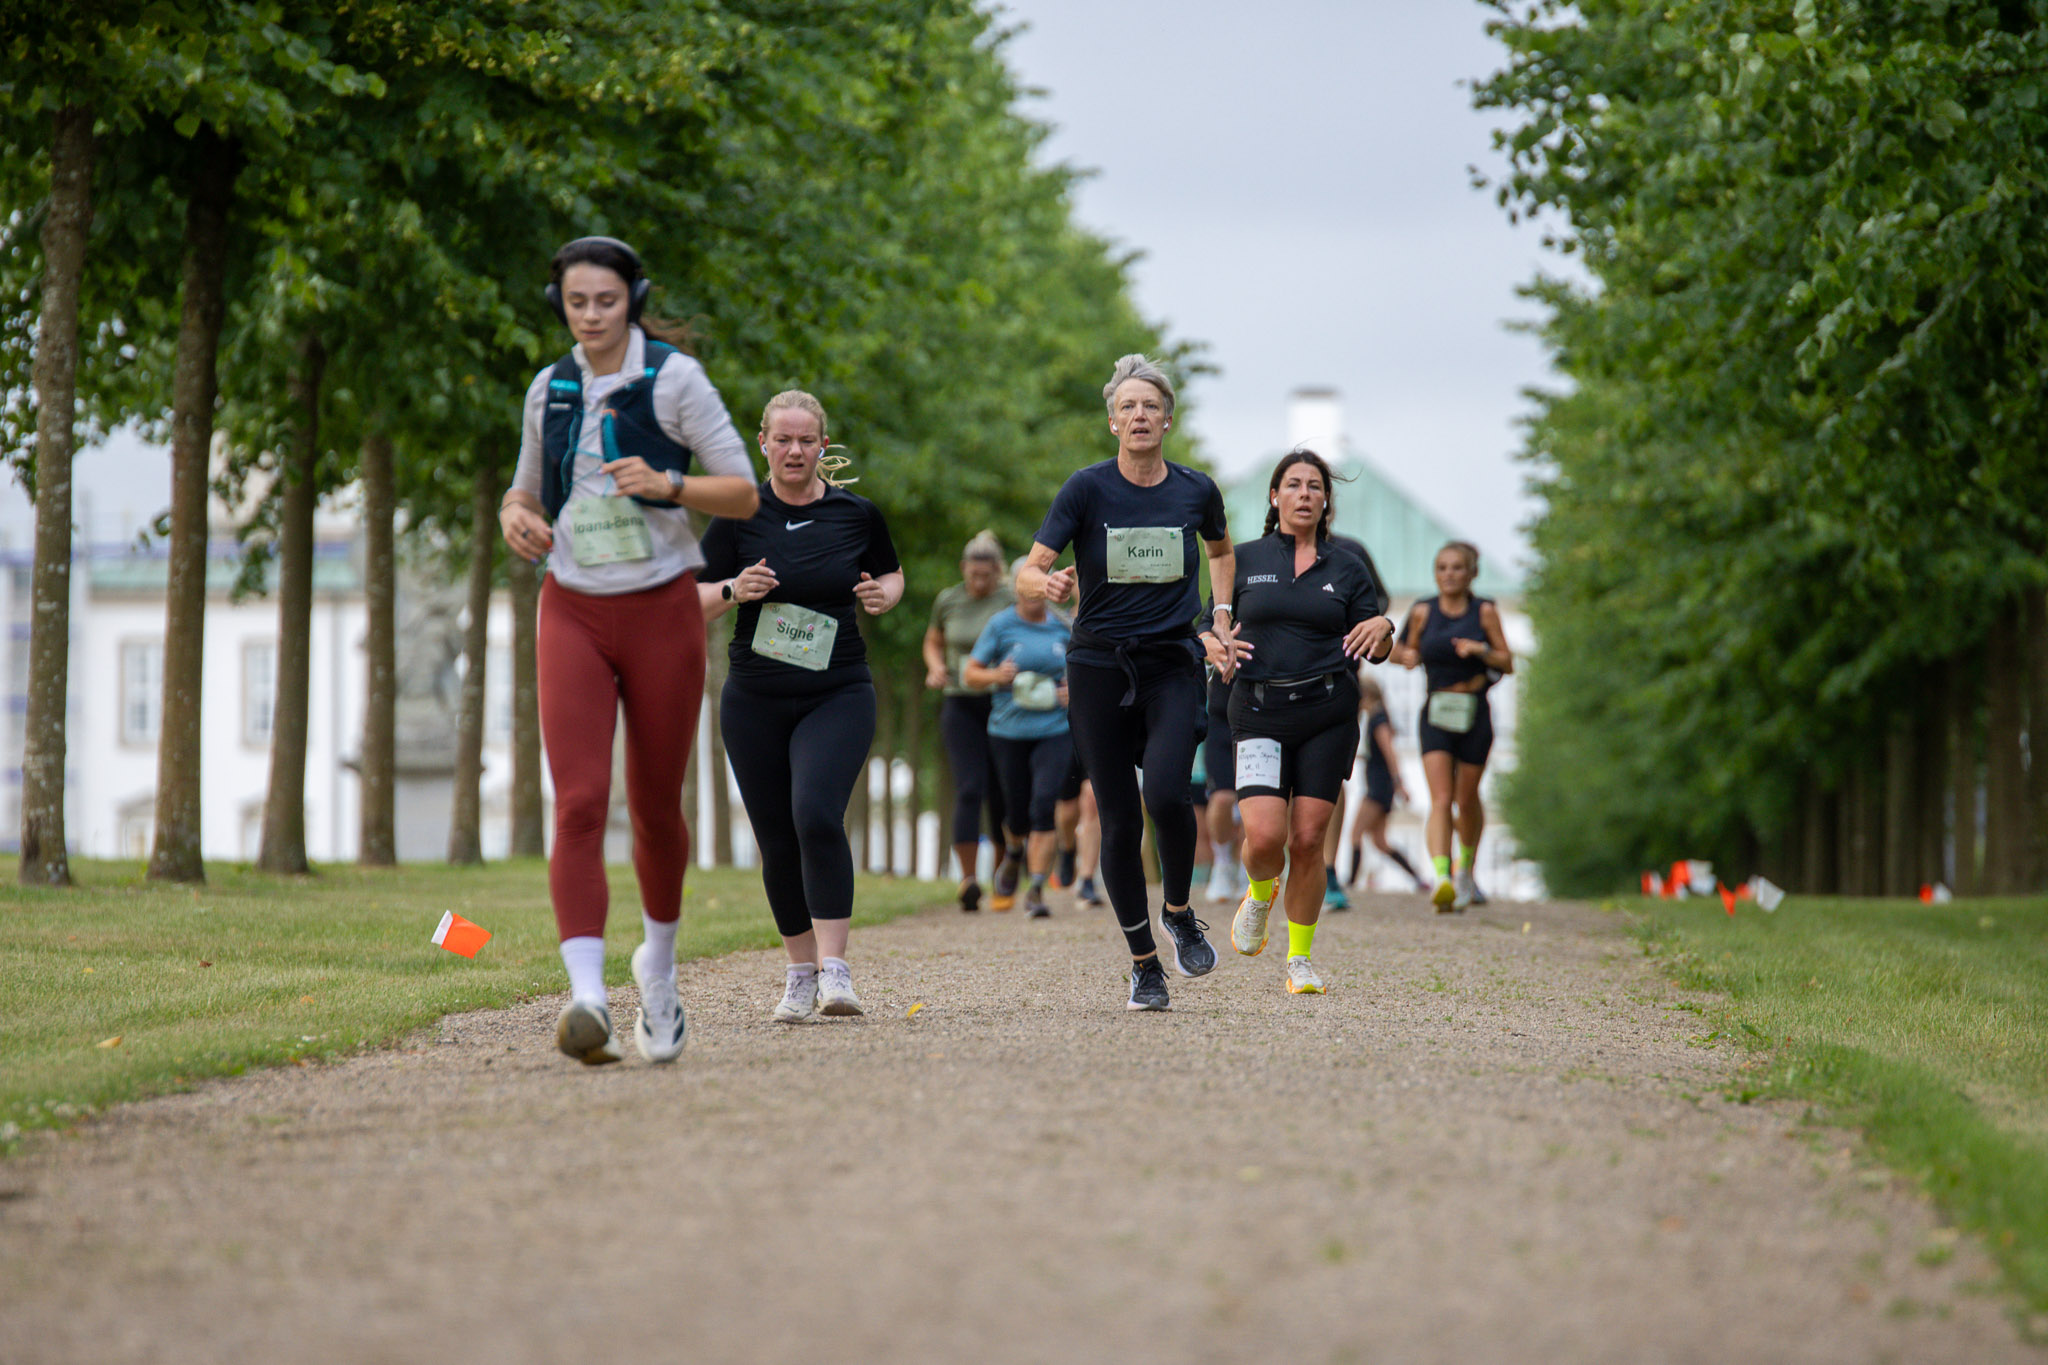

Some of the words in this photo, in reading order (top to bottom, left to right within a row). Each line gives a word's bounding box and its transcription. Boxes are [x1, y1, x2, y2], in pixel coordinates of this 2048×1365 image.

[1127, 545, 1163, 558] Karin
[1247, 574, 1279, 585] HESSEL
[776, 620, 814, 641] Signe
